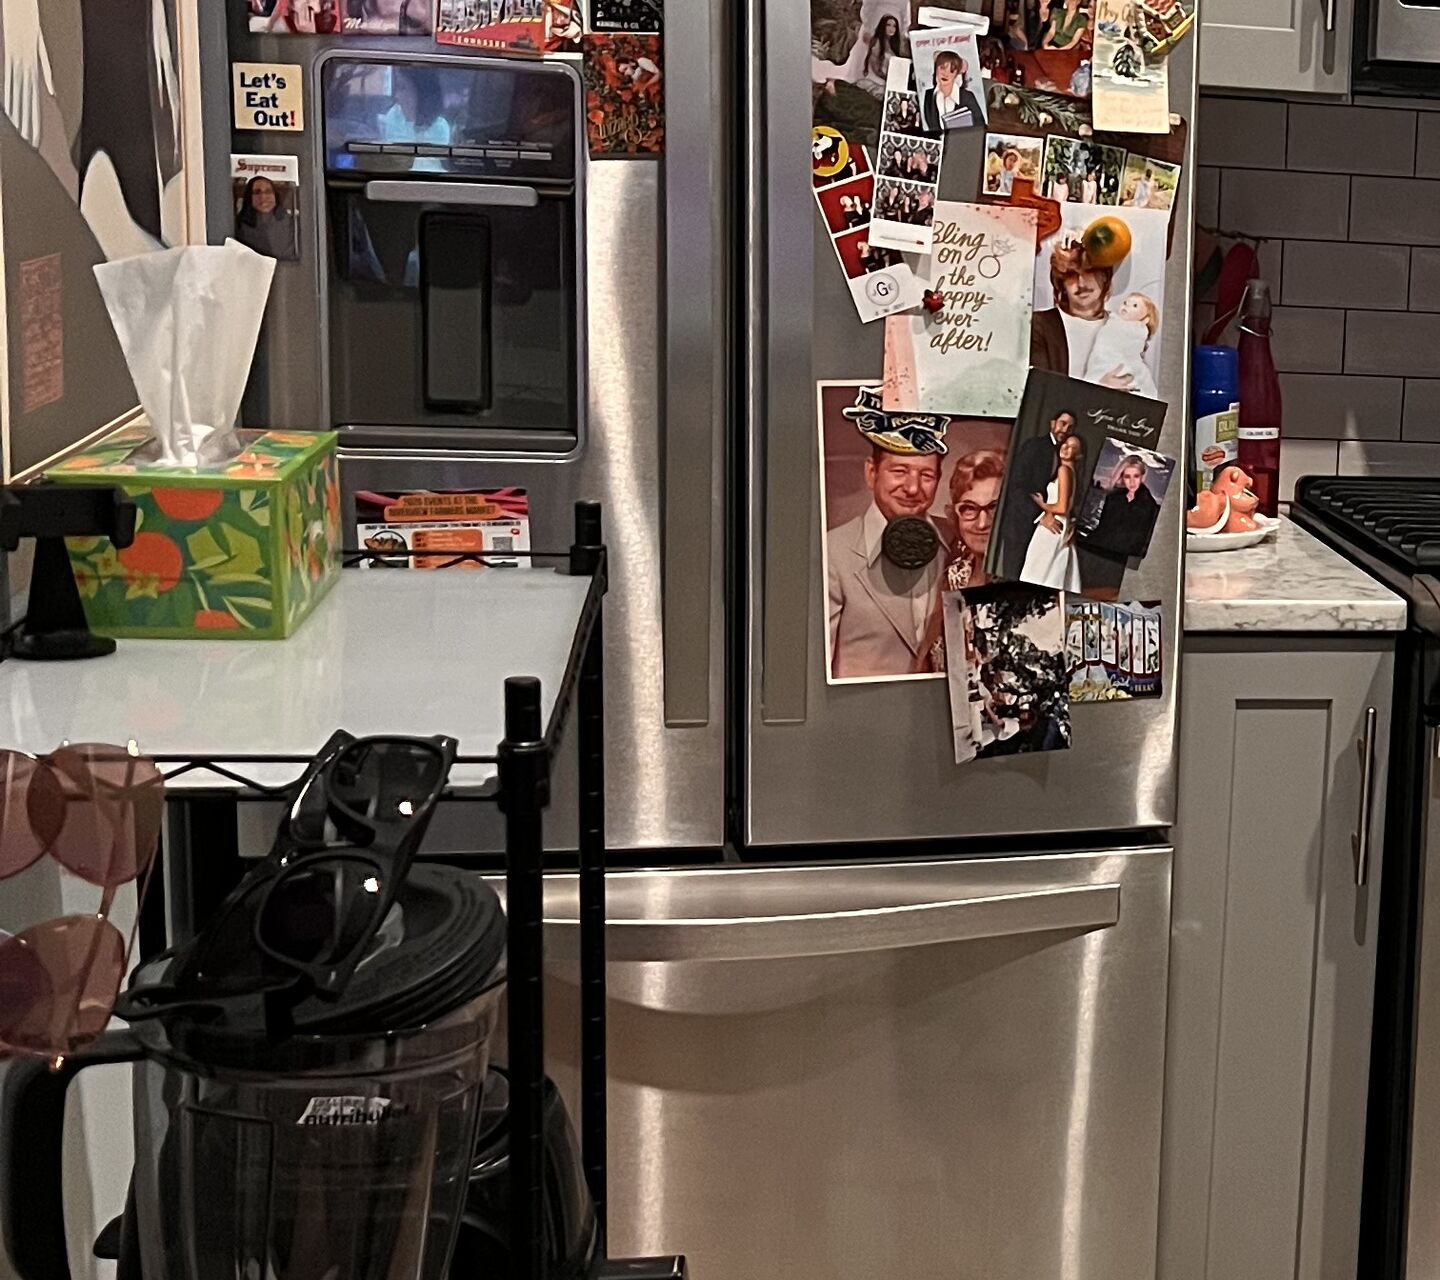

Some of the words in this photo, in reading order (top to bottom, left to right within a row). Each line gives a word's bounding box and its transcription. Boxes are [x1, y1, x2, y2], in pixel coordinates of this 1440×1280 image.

[452, 33, 507, 49] TENNESSEE
[240, 71, 287, 90] Let's
[246, 91, 279, 109] Eat
[253, 110, 296, 128] Out!
[235, 158, 287, 174] Supreme
[932, 220, 989, 261] Bling
[937, 247, 962, 265] on
[948, 265, 976, 287] the
[930, 327, 993, 355] after!
